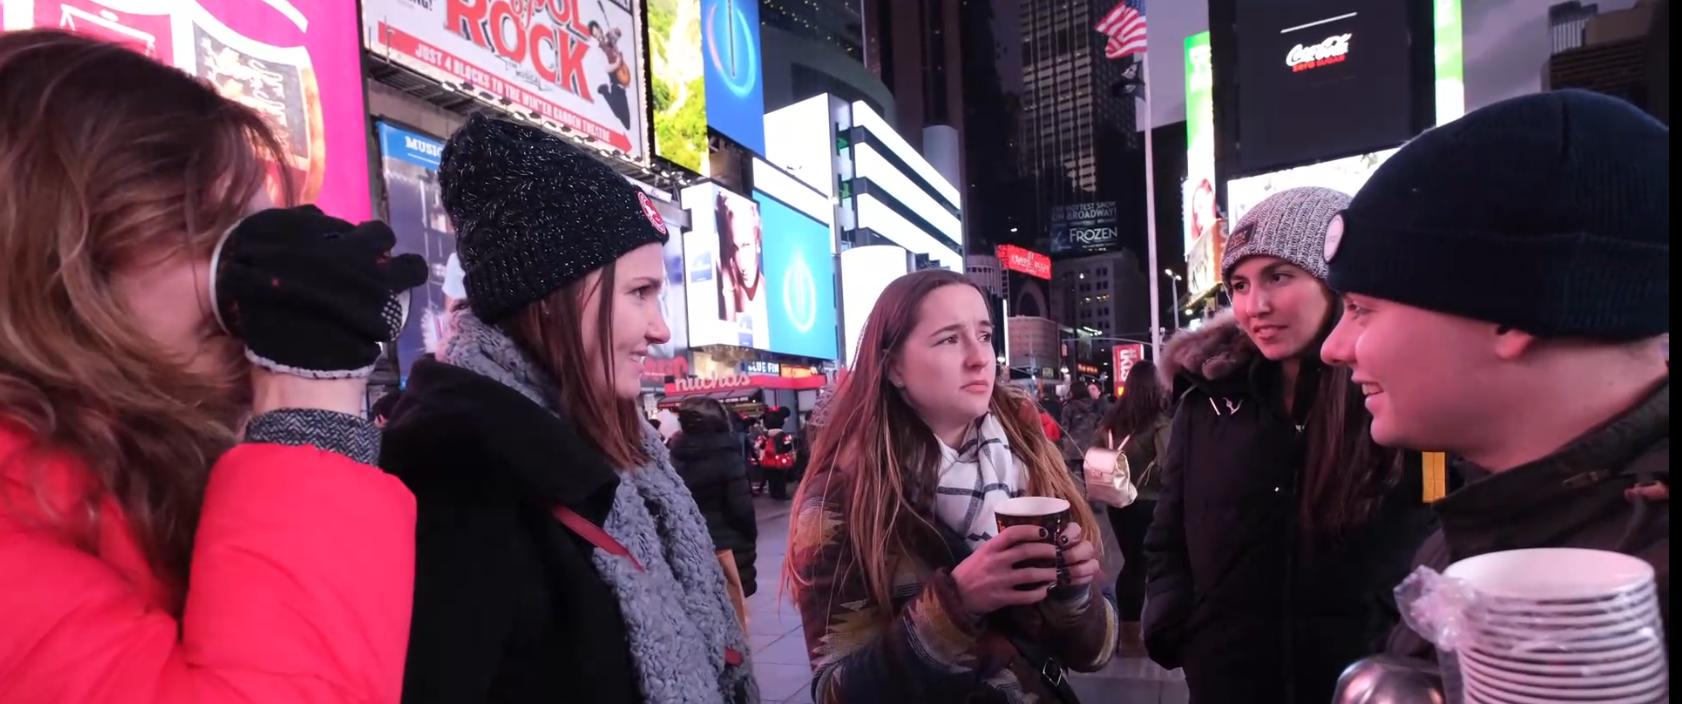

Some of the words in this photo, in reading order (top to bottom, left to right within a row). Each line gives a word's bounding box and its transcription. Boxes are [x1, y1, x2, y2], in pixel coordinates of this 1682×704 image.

[415, 42, 443, 68] JUST
[443, 55, 453, 71] 4
[453, 59, 491, 90] BLOCKS
[491, 76, 504, 96] TO
[504, 81, 521, 103] THE
[521, 88, 554, 120] WINTER
[553, 103, 583, 131] GARDEN
[443, 0, 595, 104] ROCK
[1069, 227, 1118, 244] FROZEN
